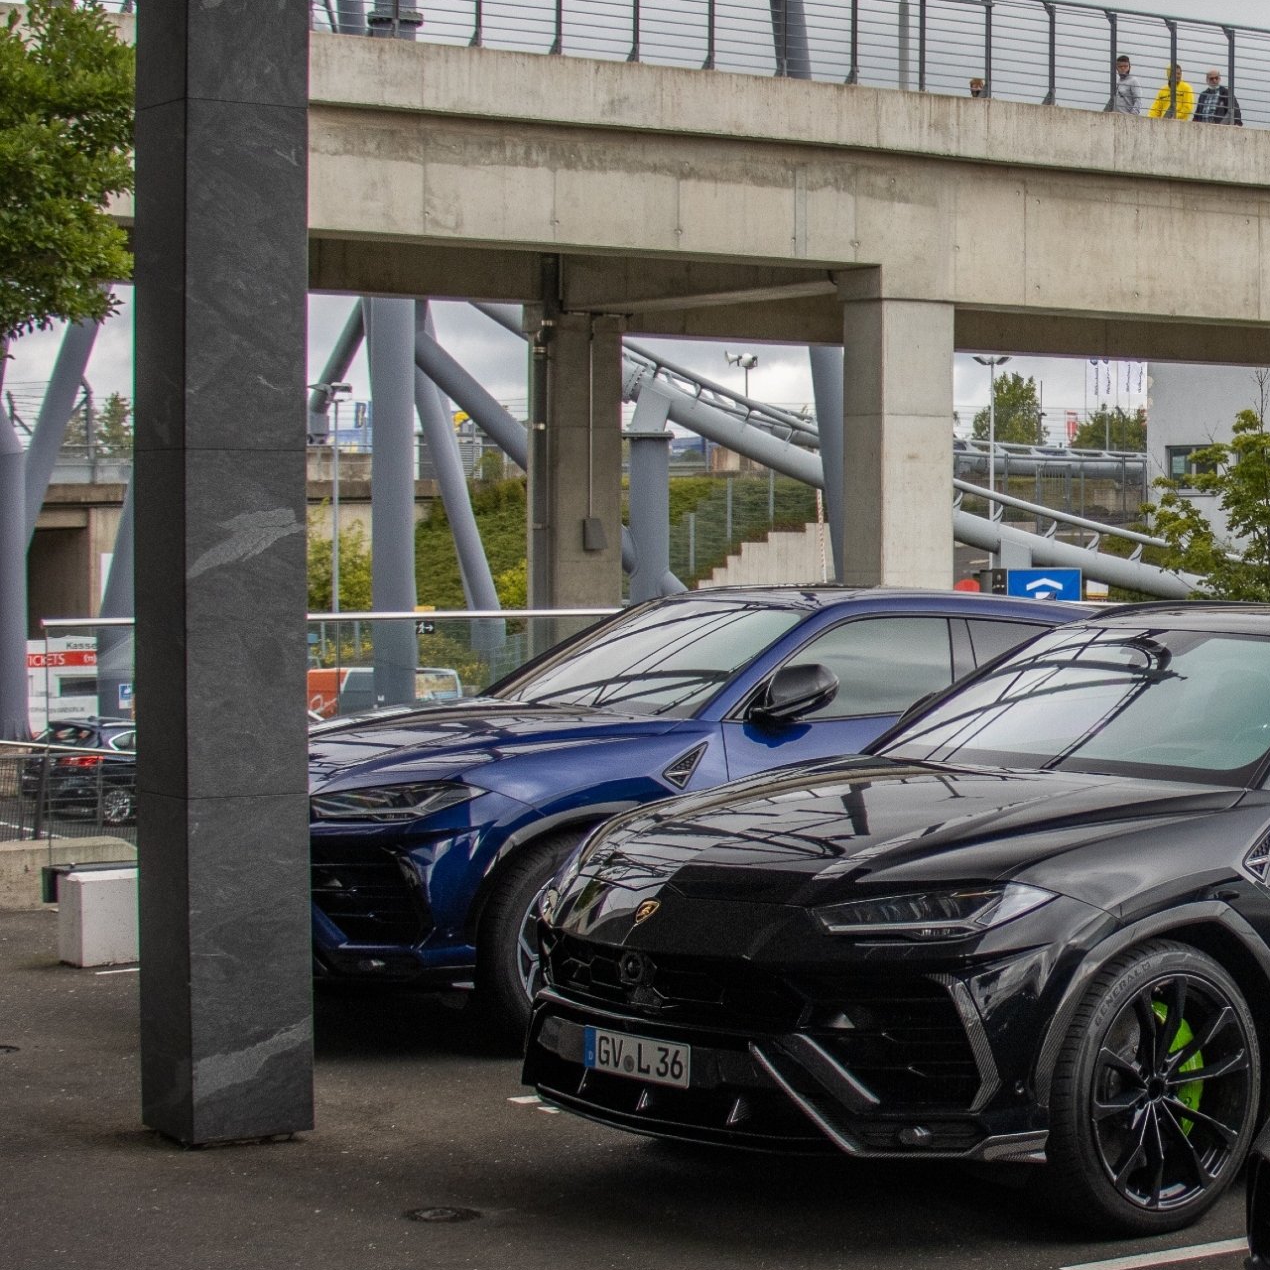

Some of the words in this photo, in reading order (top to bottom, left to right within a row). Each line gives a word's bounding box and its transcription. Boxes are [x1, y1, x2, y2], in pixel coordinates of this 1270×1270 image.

[28, 653, 65, 666] ICKETS
[1095, 970, 1141, 1027] GENERAL
[598, 1036, 623, 1068] GV
[656, 1047, 683, 1079] 36
